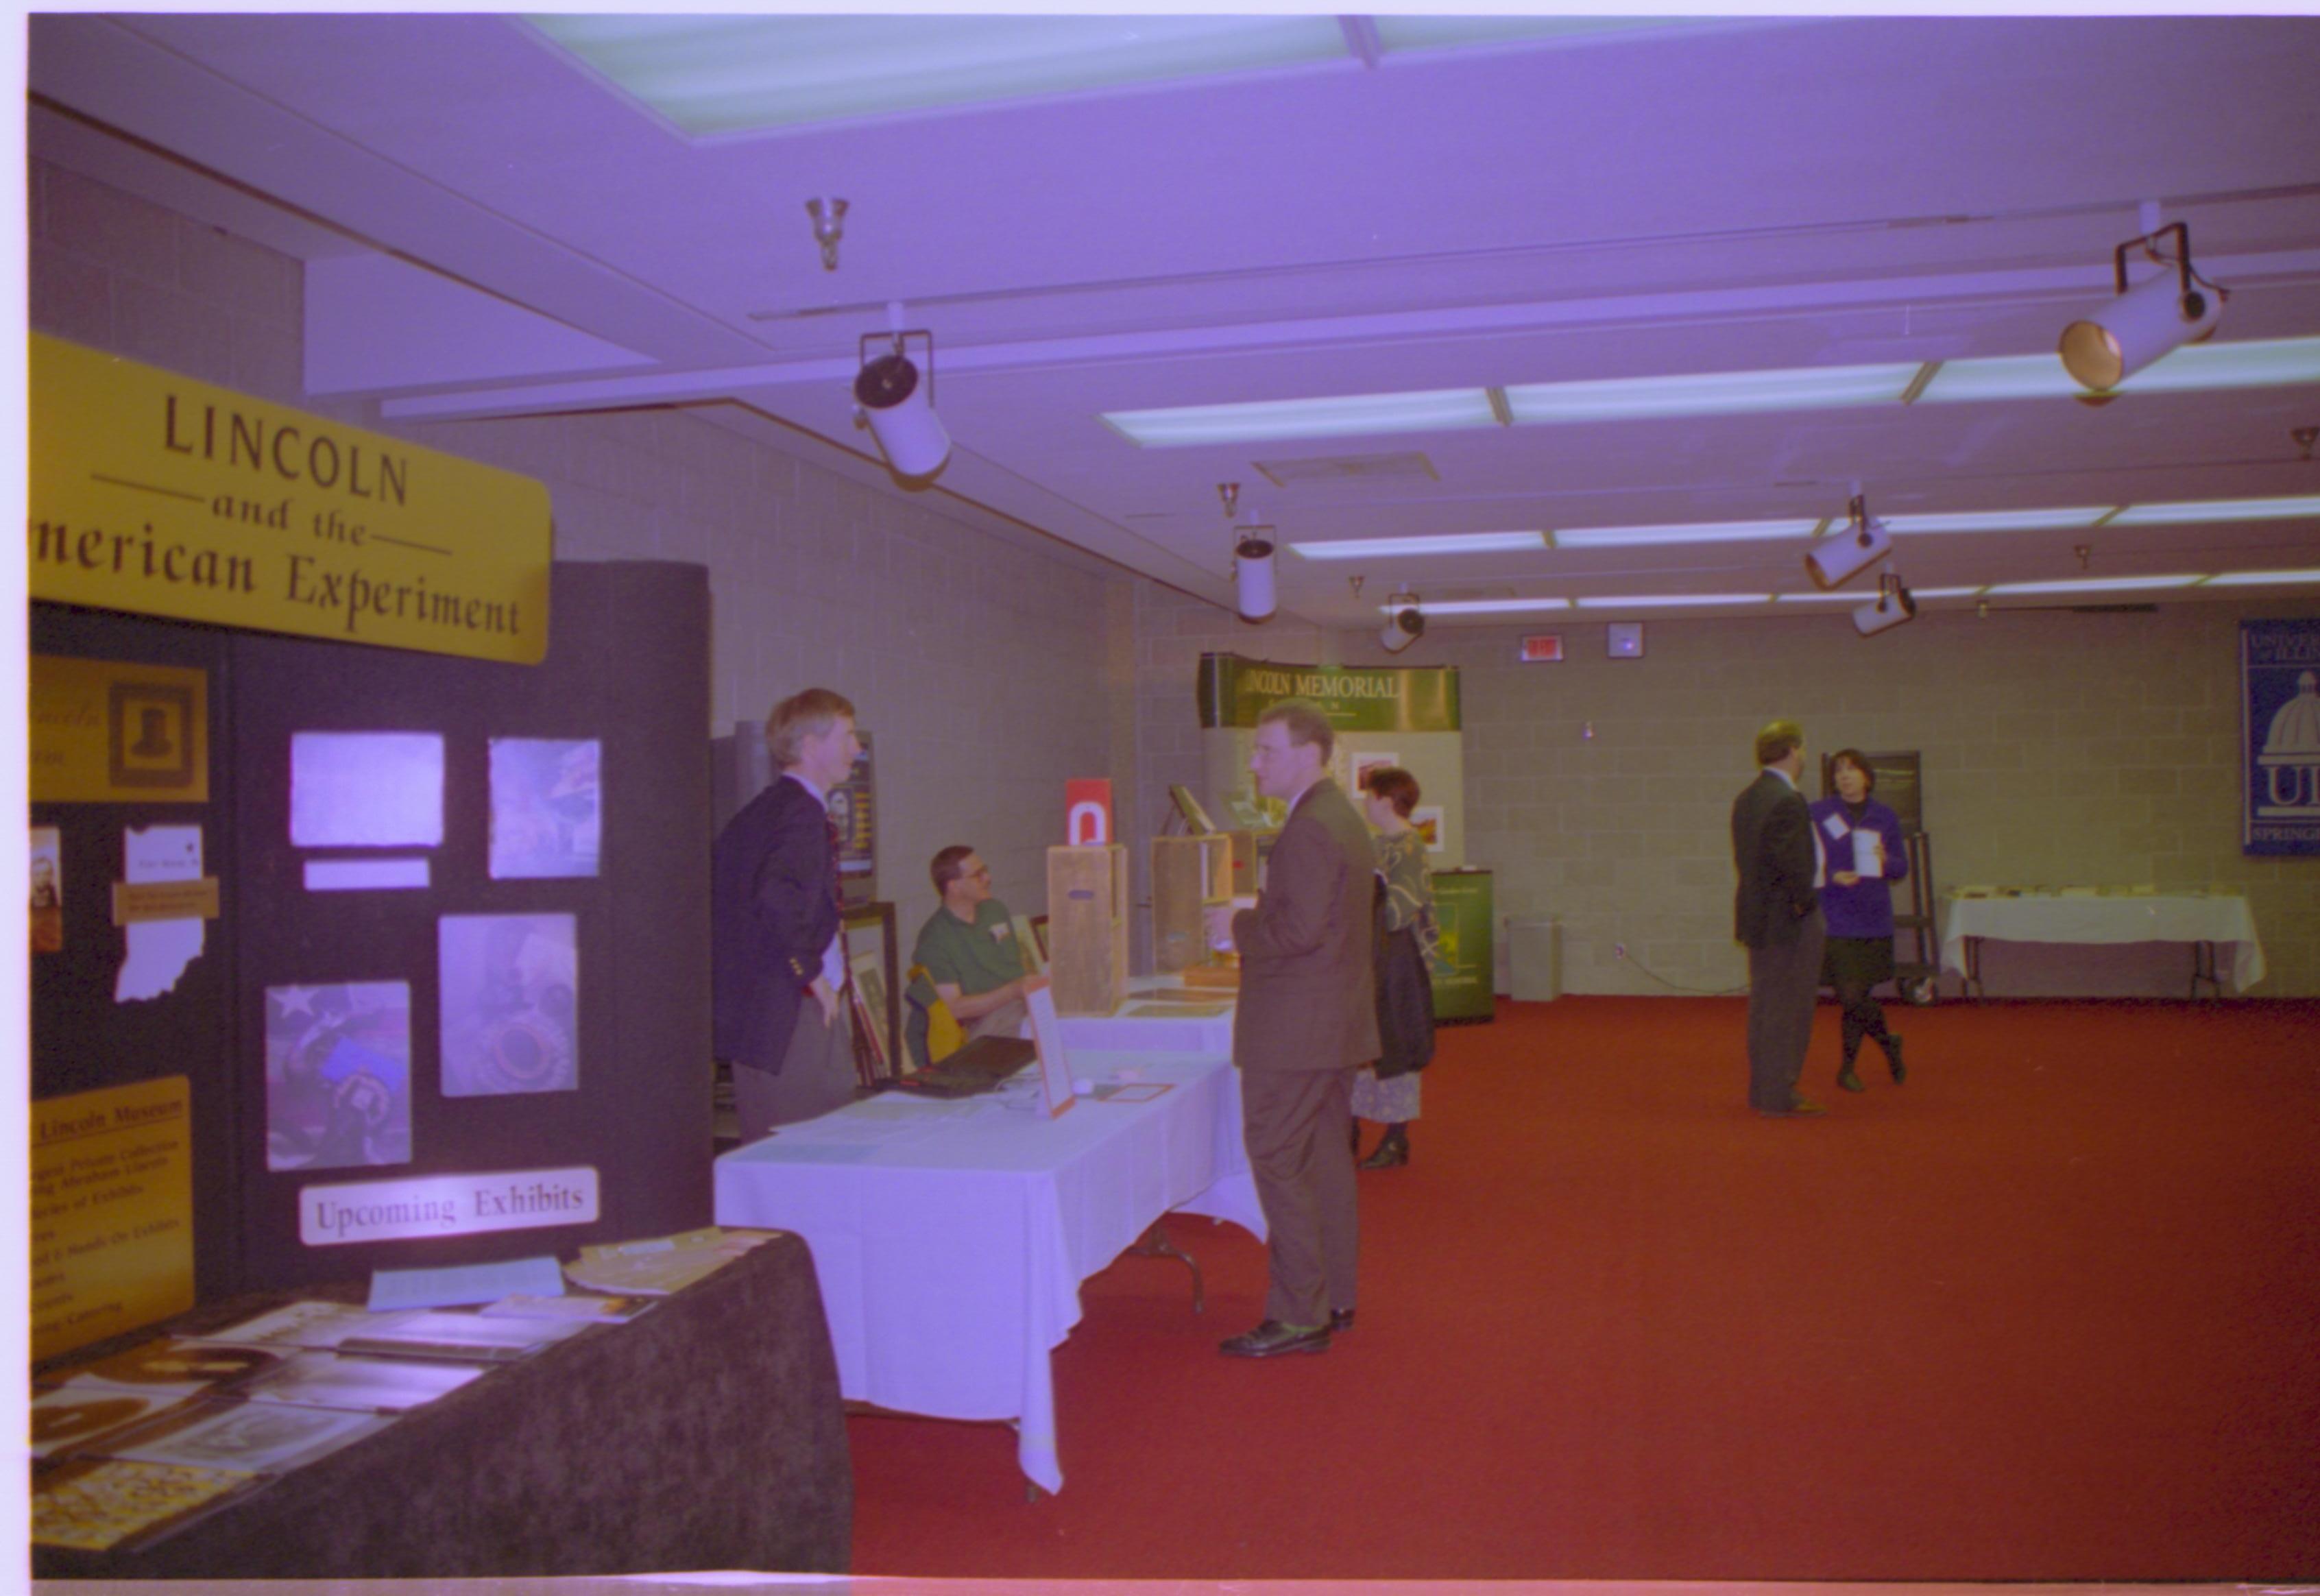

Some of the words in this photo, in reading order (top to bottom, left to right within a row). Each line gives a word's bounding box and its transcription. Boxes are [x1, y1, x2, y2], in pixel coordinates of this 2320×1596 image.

[165, 394, 407, 507] LINCOLN
[213, 492, 291, 531] and
[313, 509, 367, 547] the
[287, 553, 520, 635] Experiment
[1295, 674, 1399, 698] MEMORIAL
[39, 1111, 106, 1140] Lincoln
[114, 1100, 184, 1123] Museum
[61, 1168, 121, 1189] Abraham
[124, 1156, 169, 1175] Lincoln
[70, 1154, 115, 1171] Private
[120, 1141, 180, 1161] Collection
[73, 1196, 87, 1210] of
[92, 1185, 144, 1205] Exhibits
[316, 1196, 456, 1237] Upcoming
[474, 1183, 583, 1217] Exhibits
[132, 1219, 180, 1239] Exhibits
